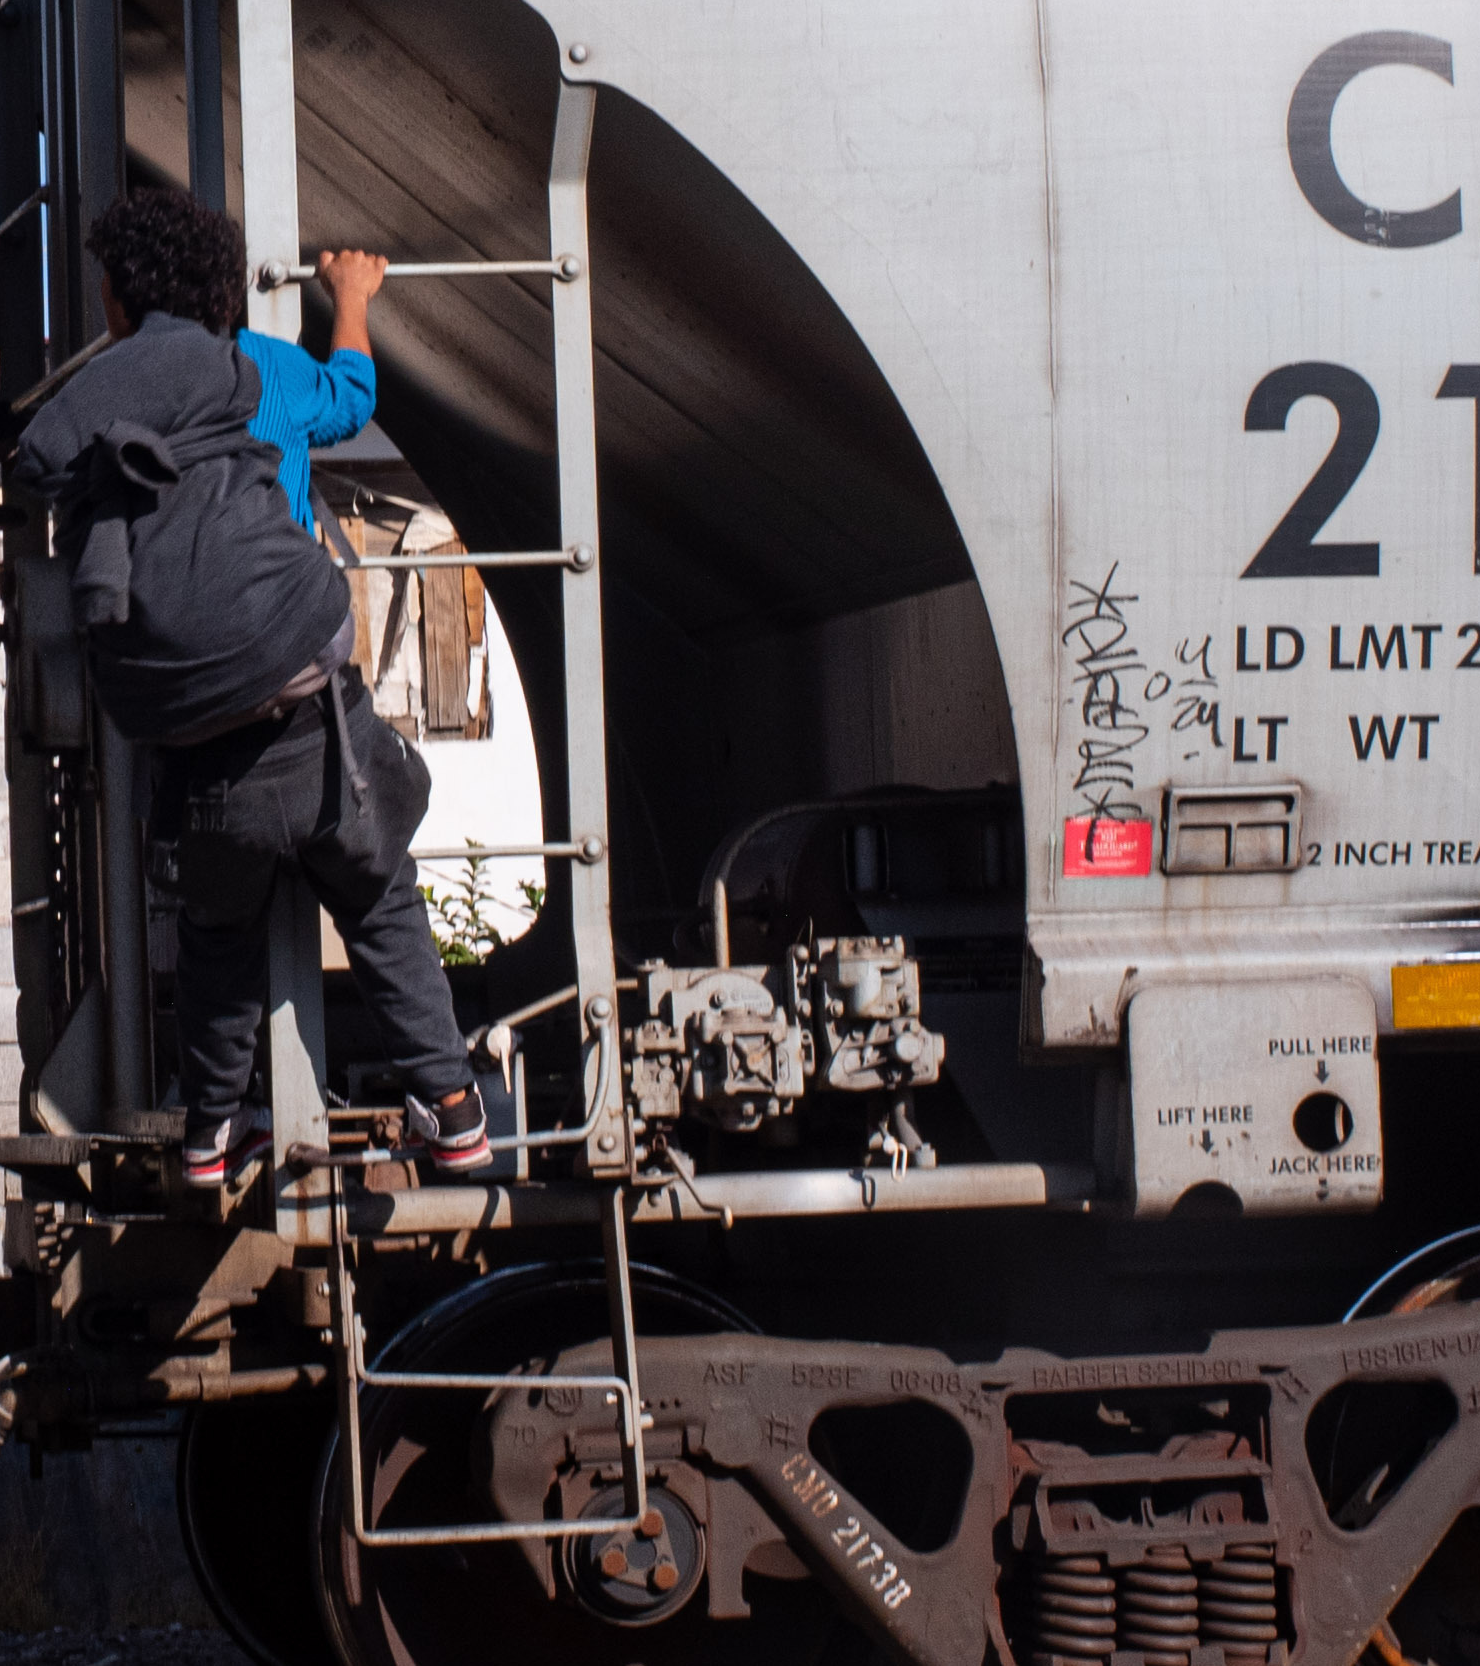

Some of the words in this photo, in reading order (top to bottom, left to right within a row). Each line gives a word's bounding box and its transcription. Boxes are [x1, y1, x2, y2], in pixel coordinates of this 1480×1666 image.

[1238, 626, 1305, 671] LD
[1330, 624, 1443, 670] LMT
[1234, 716, 1289, 762] LT
[1350, 714, 1440, 761] WT
[1334, 842, 1412, 866] INCH
[1269, 1038, 1314, 1056] PULL
[1321, 1036, 1372, 1055] HERE
[1157, 1107, 1194, 1126] LIFT
[1203, 1105, 1253, 1124] HERE
[1269, 1157, 1318, 1176] JACK
[1326, 1155, 1377, 1174] HERE
[782, 1452, 841, 1518] CMO
[831, 1516, 912, 1610] 21738
